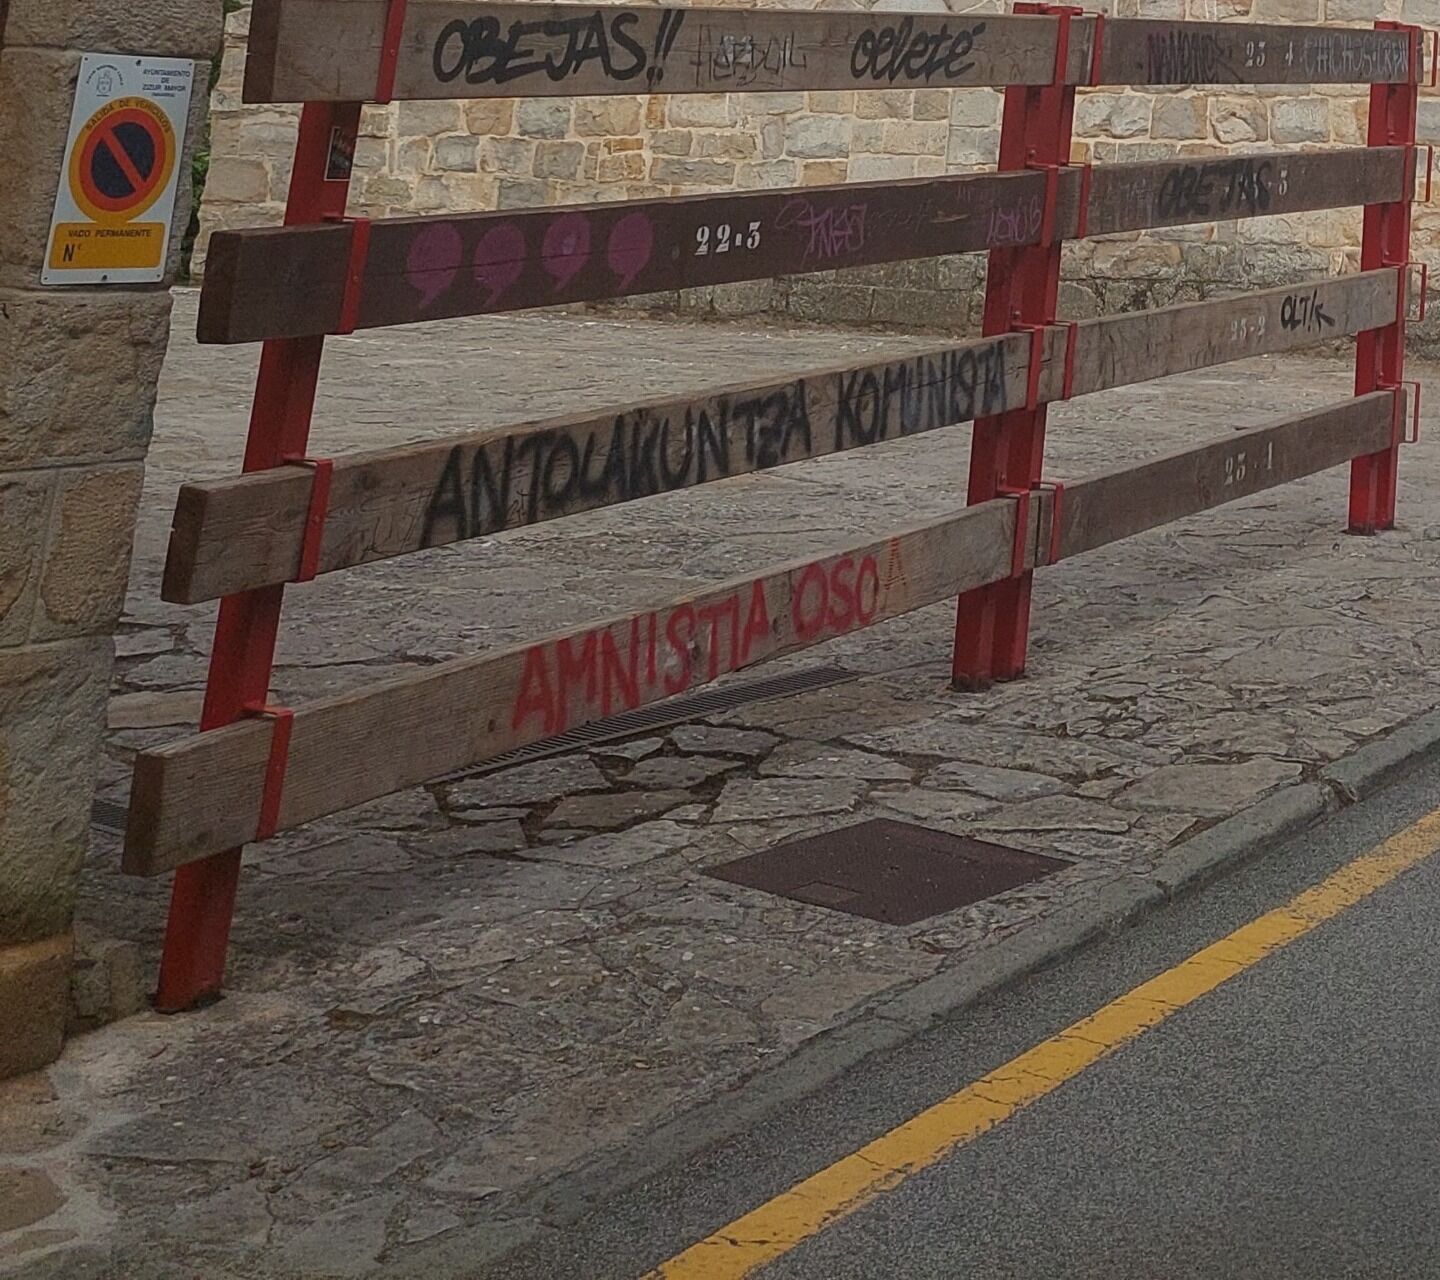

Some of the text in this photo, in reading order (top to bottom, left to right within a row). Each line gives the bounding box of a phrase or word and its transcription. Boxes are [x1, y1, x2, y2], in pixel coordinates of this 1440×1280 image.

[68, 228, 153, 238] VADO PERMANENTE
[510, 578, 771, 735] AMNISTIA
